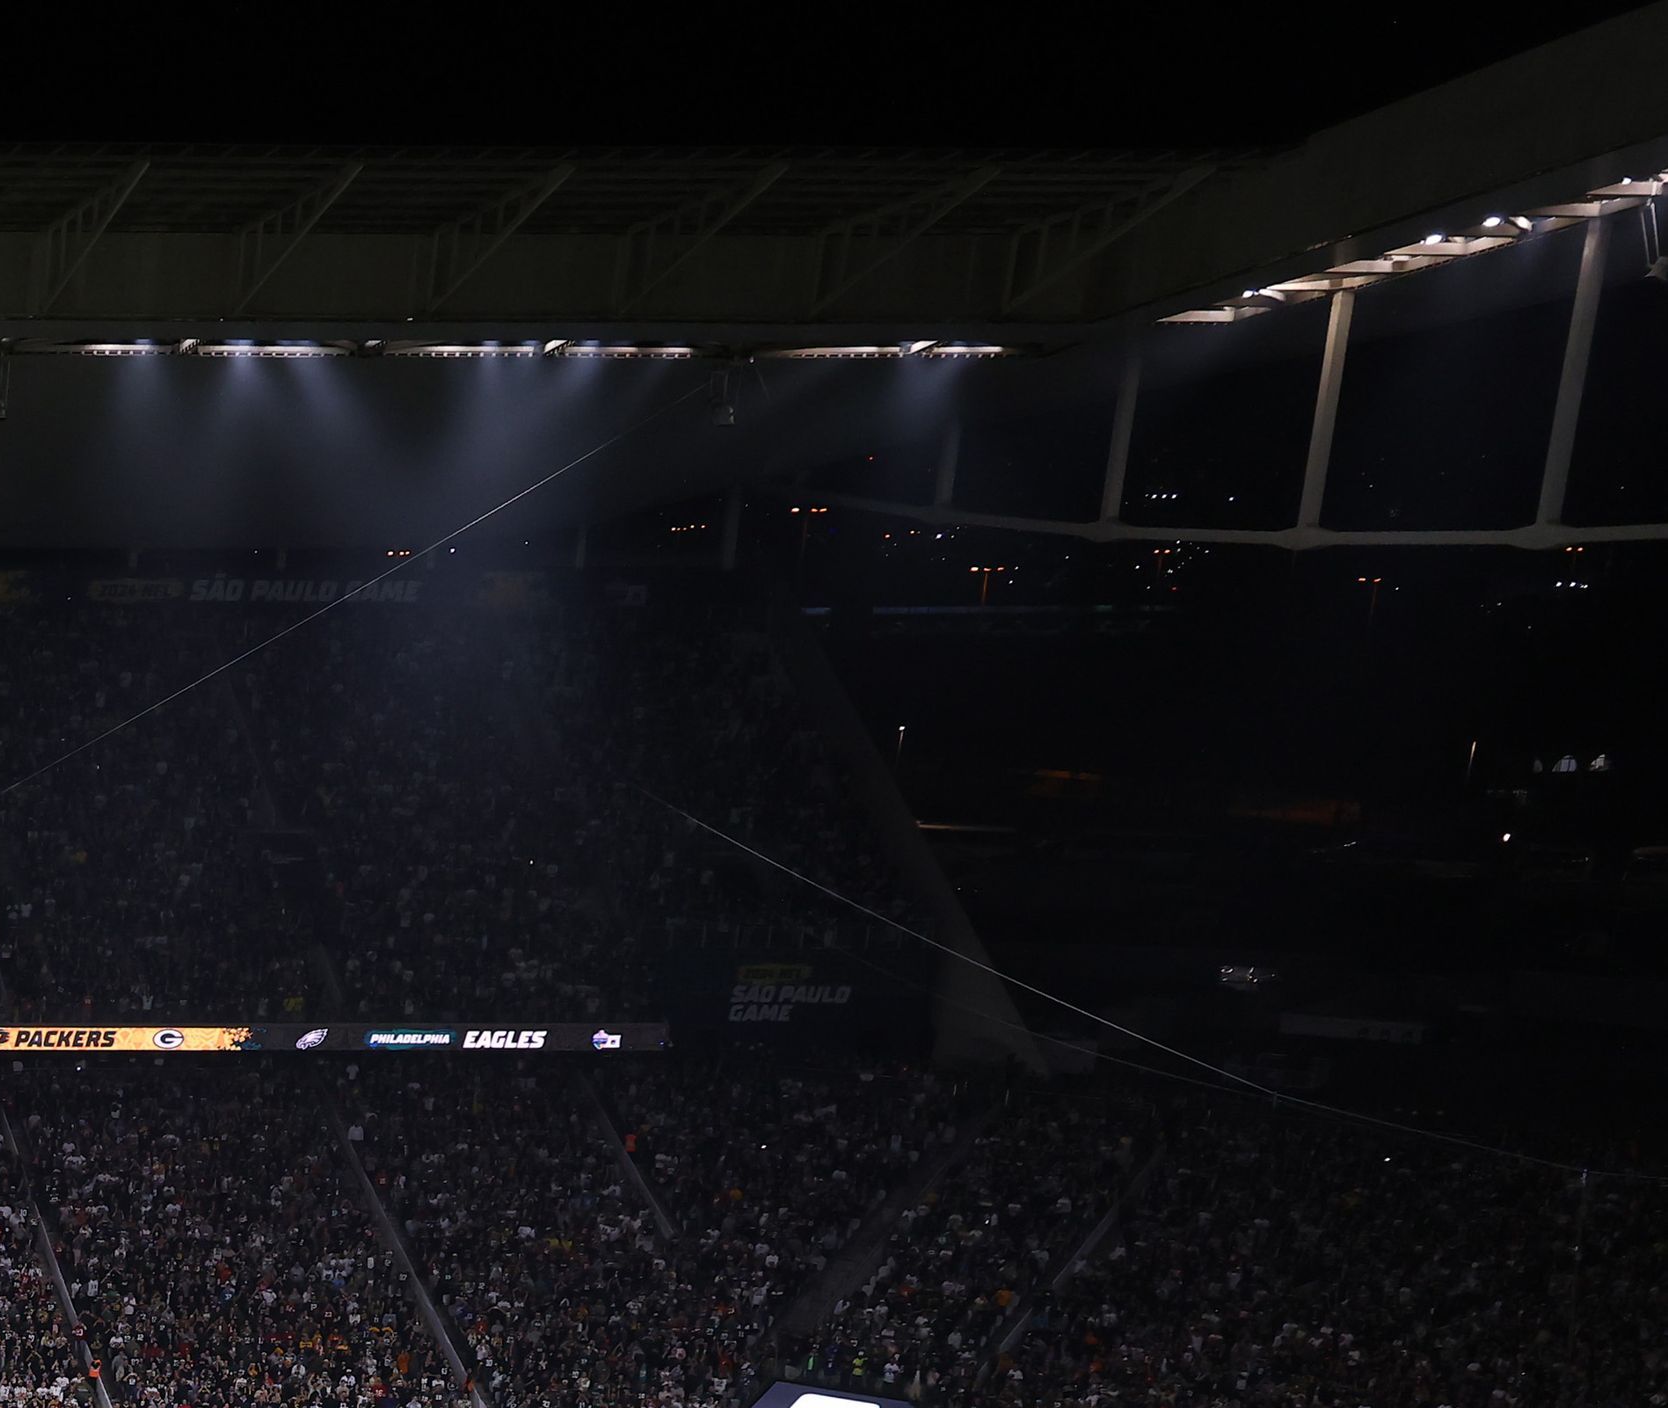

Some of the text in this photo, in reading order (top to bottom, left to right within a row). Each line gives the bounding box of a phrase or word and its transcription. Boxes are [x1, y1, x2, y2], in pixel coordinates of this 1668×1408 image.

[190, 573, 240, 602] SÃO
[250, 579, 342, 602] PAULO
[778, 985, 852, 1004] PAULO
[728, 1004, 794, 1022] GAME
[15, 1029, 117, 1047] PACKERS
[369, 1030, 548, 1049] PHILADELPHIA EAGLES
